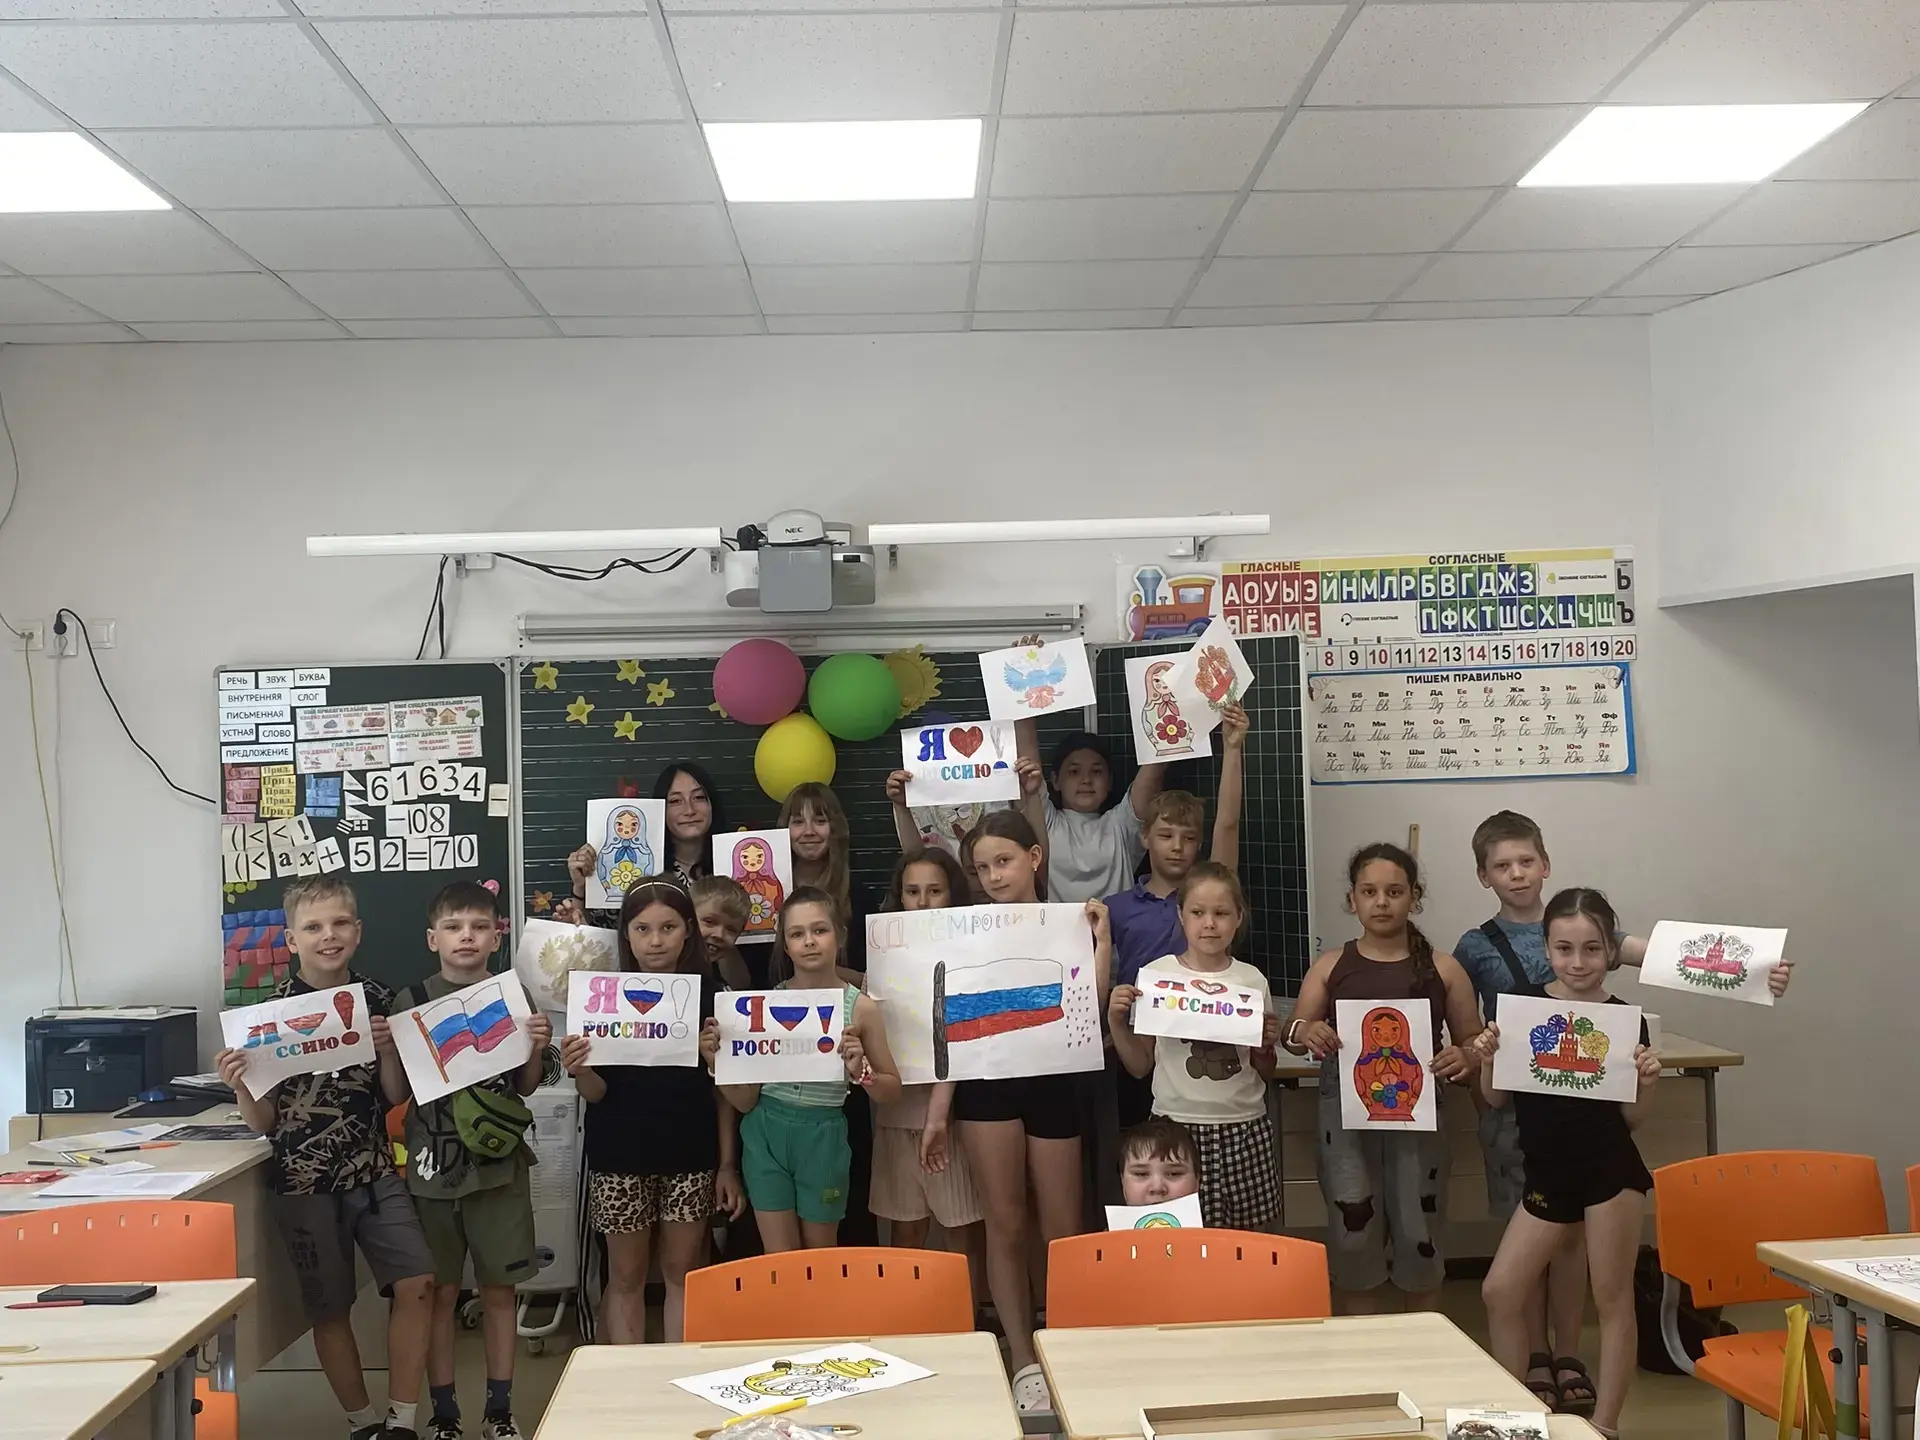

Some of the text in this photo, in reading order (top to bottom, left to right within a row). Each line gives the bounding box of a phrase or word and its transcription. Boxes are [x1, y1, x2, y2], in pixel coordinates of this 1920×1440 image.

[1429, 553, 1506, 565] СОГЛАСНЫЕ
[1241, 561, 1301, 573] ГЛАСНЫЕ
[1325, 640, 1633, 666] 8 9 10 11 12 13 14 15 16 17 18 19 20
[226, 676, 248, 685] РЕЧЬ
[266, 675, 287, 684] ЗВУК
[299, 673, 326, 682] БУКВА
[1407, 672, 1522, 685] ПИШЕМ ПРАВИЛЬНО
[228, 693, 282, 703] ВНУТРЕННЯЯ
[298, 693, 320, 701] СЛОГ
[227, 709, 284, 720] ПИСЬМЕННАЯ
[222, 728, 254, 737] УСТНАЯ
[262, 729, 291, 738] СЛОВО
[917, 729, 947, 762] Я
[226, 748, 289, 758] ПРЕДЛОЖЕНИЕ
[930, 764, 992, 781] ССИЮ
[584, 976, 620, 1014] Я
[582, 1020, 668, 1039] РОССИЮ
[262, 1036, 339, 1061] ССИЮ
